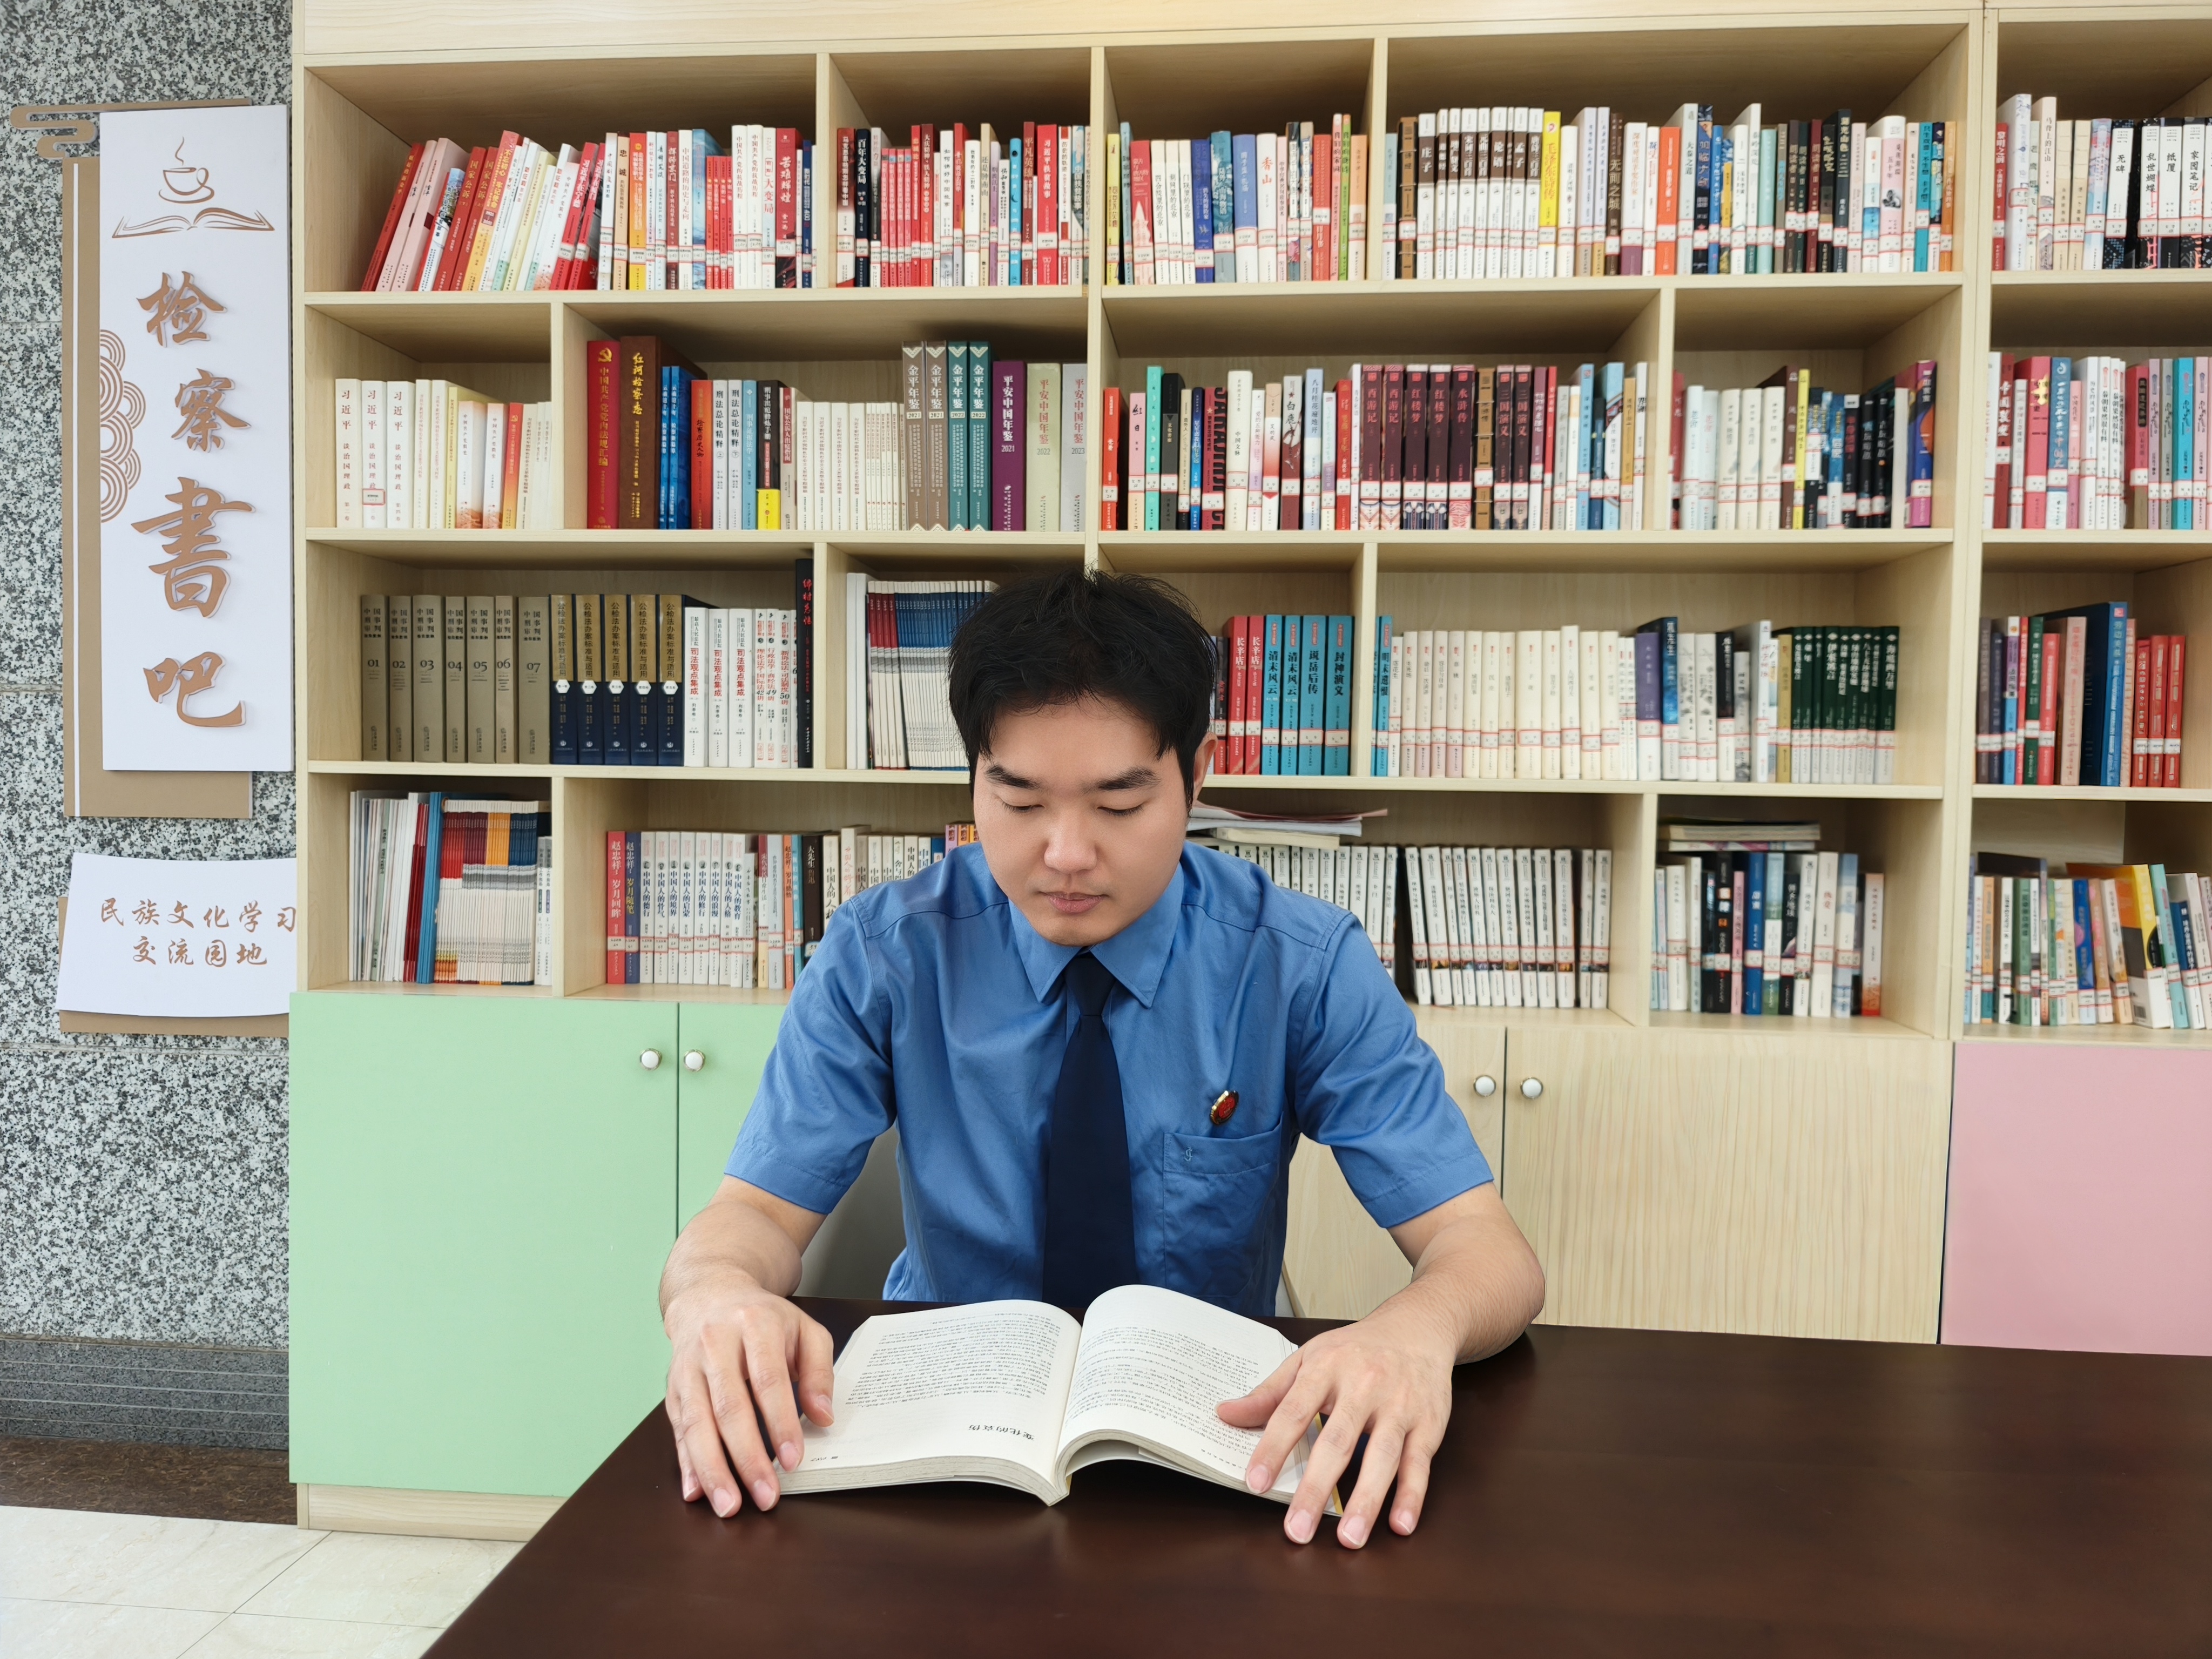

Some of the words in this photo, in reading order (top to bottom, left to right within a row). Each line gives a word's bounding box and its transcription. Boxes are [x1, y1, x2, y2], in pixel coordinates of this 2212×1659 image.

[462, 160, 479, 199] 国家公诉
[477, 160, 494, 200] 国家公诉
[857, 138, 867, 184] 百年大变局
[1262, 157, 1274, 186] 香山
[2114, 154, 2127, 173] 无碑
[2146, 152, 2156, 193] 乱世蝴蝶
[2166, 152, 2177, 173] 纸厦
[2189, 150, 2200, 192] 家园笔记
[631, 352, 645, 415] 红河检察志
[908, 364, 920, 410] 金平年鉴
[930, 364, 942, 410] 金平年鉴
[952, 364, 964, 410] 金平年鉴
[973, 364, 985, 410] 金平年鉴
[1366, 388, 1378, 423] 西游记
[1388, 388, 1399, 423] 西游记
[1410, 388, 1422, 424] 红楼梦
[1433, 388, 1445, 424] 红楼梦
[341, 389, 352, 430] 习近平
[367, 389, 377, 430] 习近平
[393, 391, 403, 431] 习近平
[715, 390, 724, 449] 刑法总论精释
[731, 389, 740, 448] 刑法总论精释
[1002, 375, 1014, 442] 平安中国年鉴
[1038, 379, 1049, 445] 平安中国年鉴
[1074, 379, 1084, 444] 平安中国年鉴
[1499, 390, 1510, 436] 三国演义
[1517, 389, 1529, 436] 三国演义
[342, 442, 351, 490] 谈治国理政
[394, 443, 402, 491] 谈治国理政
[131, 270, 257, 730] 检察書吧
[447, 609, 463, 617] 中国
[557, 602, 567, 678] 公检法办案标准与适用
[583, 602, 594, 679] 公检法办案标准与适用
[611, 602, 621, 678] 公检法办案标准与适用
[638, 602, 648, 679] 公检法办案标准与适用
[666, 602, 675, 678] 公检法办案标准与适用
[367, 659, 380, 667] 01
[392, 660, 406, 669] 02
[420, 660, 435, 671] 03
[448, 661, 463, 672] 04
[474, 661, 488, 672] 05
[497, 658, 511, 669] 06
[527, 663, 541, 673] 07
[690, 648, 699, 696] 司法观点集成
[713, 650, 722, 697] 司法观点集成
[737, 649, 745, 697] 司法观点集成
[1267, 650, 1279, 694] 清末风云
[1287, 652, 1298, 696] 清末风云
[1307, 650, 1320, 694] 说岳后传
[1334, 652, 1345, 697] 封神演义
[611, 840, 622, 875] 赵忠祥
[626, 841, 635, 874] 赵忠祥
[100, 897, 296, 933] 民族文化学习
[611, 880, 622, 919] 岁月回眸
[626, 878, 636, 915] 岁月随笔
[642, 872, 651, 918] 中国人的德行
[657, 872, 665, 918] 中国人的骨气
[670, 870, 678, 917] 中国人的境界
[683, 872, 691, 918] 中国人的启蒙
[698, 871, 706, 918] 中国人的修行
[711, 872, 719, 918] 中国人的浪漫
[724, 872, 732, 918] 中国人的人格
[734, 874, 743, 921] 中国人的教育
[132, 935, 267, 968] 交流园地
